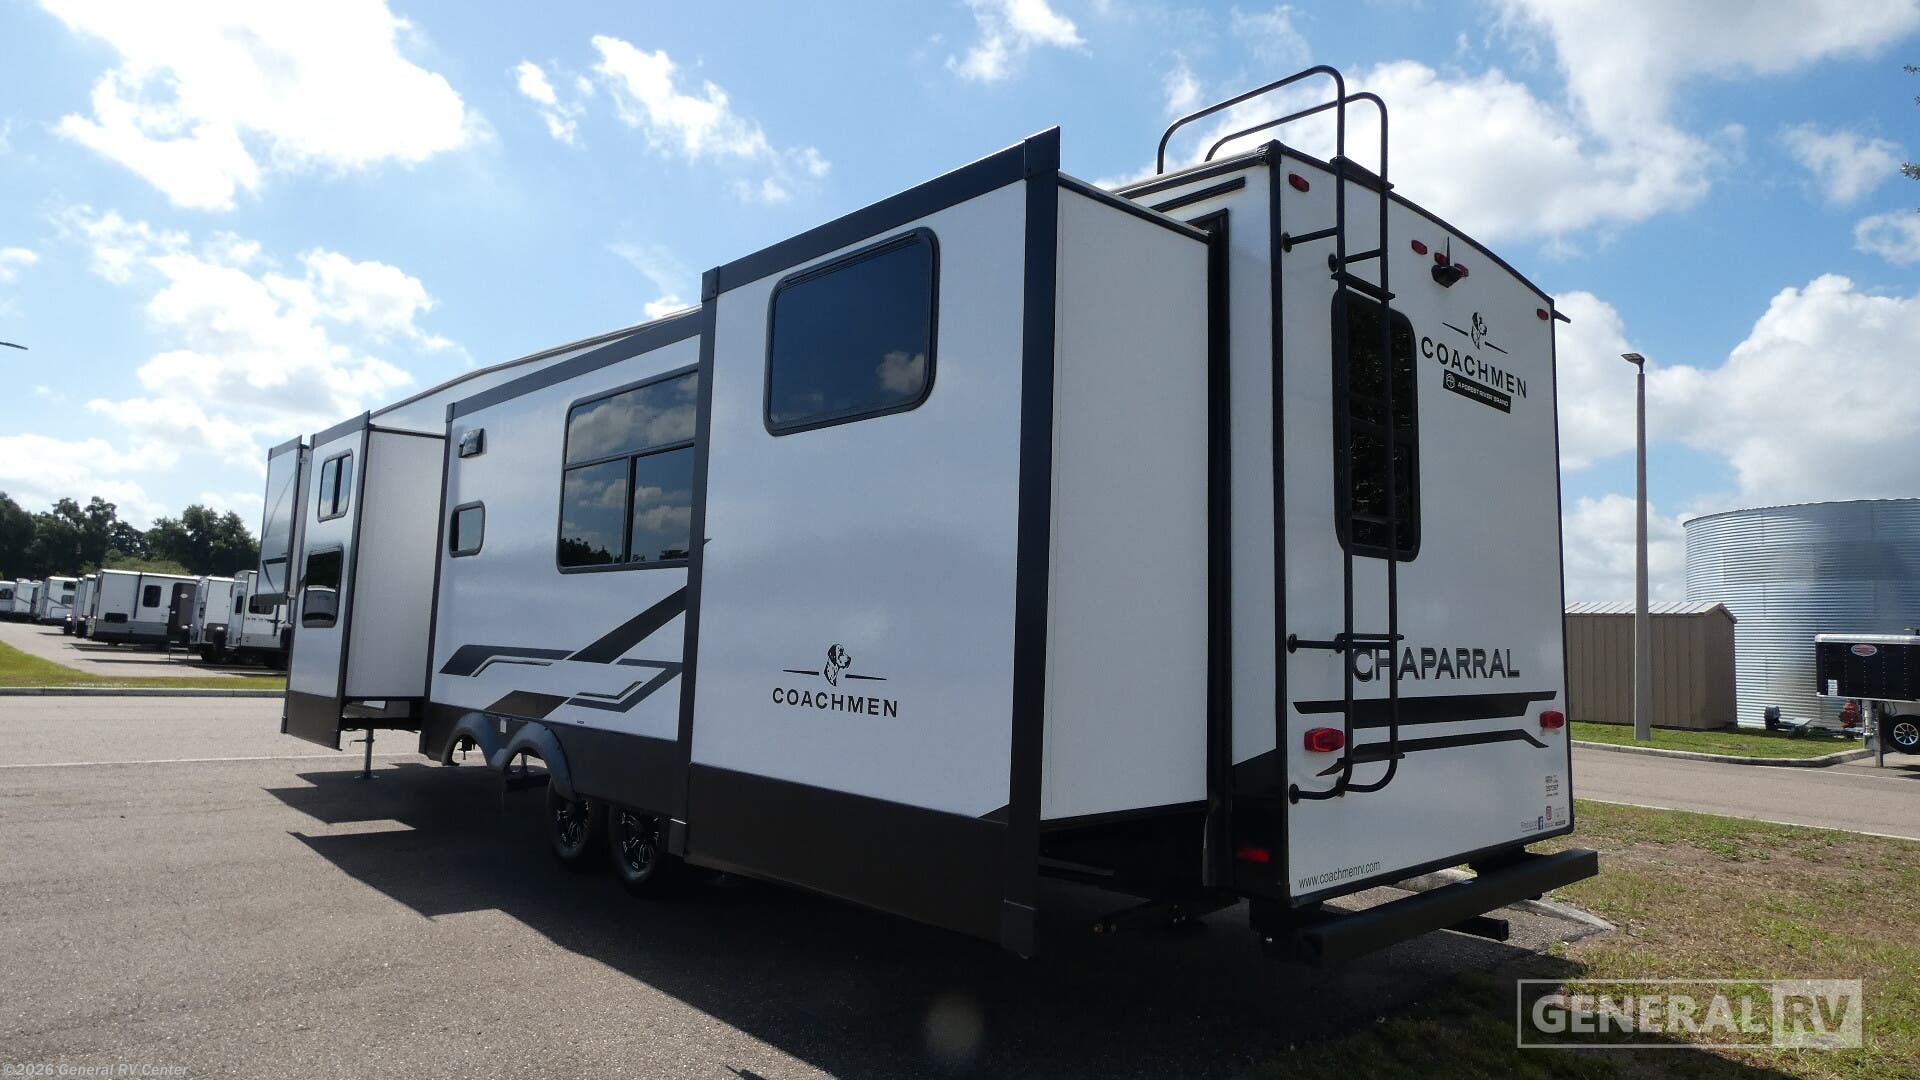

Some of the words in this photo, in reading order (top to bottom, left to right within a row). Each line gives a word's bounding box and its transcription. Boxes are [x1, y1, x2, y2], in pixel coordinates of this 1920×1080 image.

[1421, 336, 1527, 399] COACHMEN
[1353, 646, 1521, 683] CHAPARRAL
[772, 687, 898, 718] COACHMEN
[1299, 861, 1381, 888] www.coachmenrv.com
